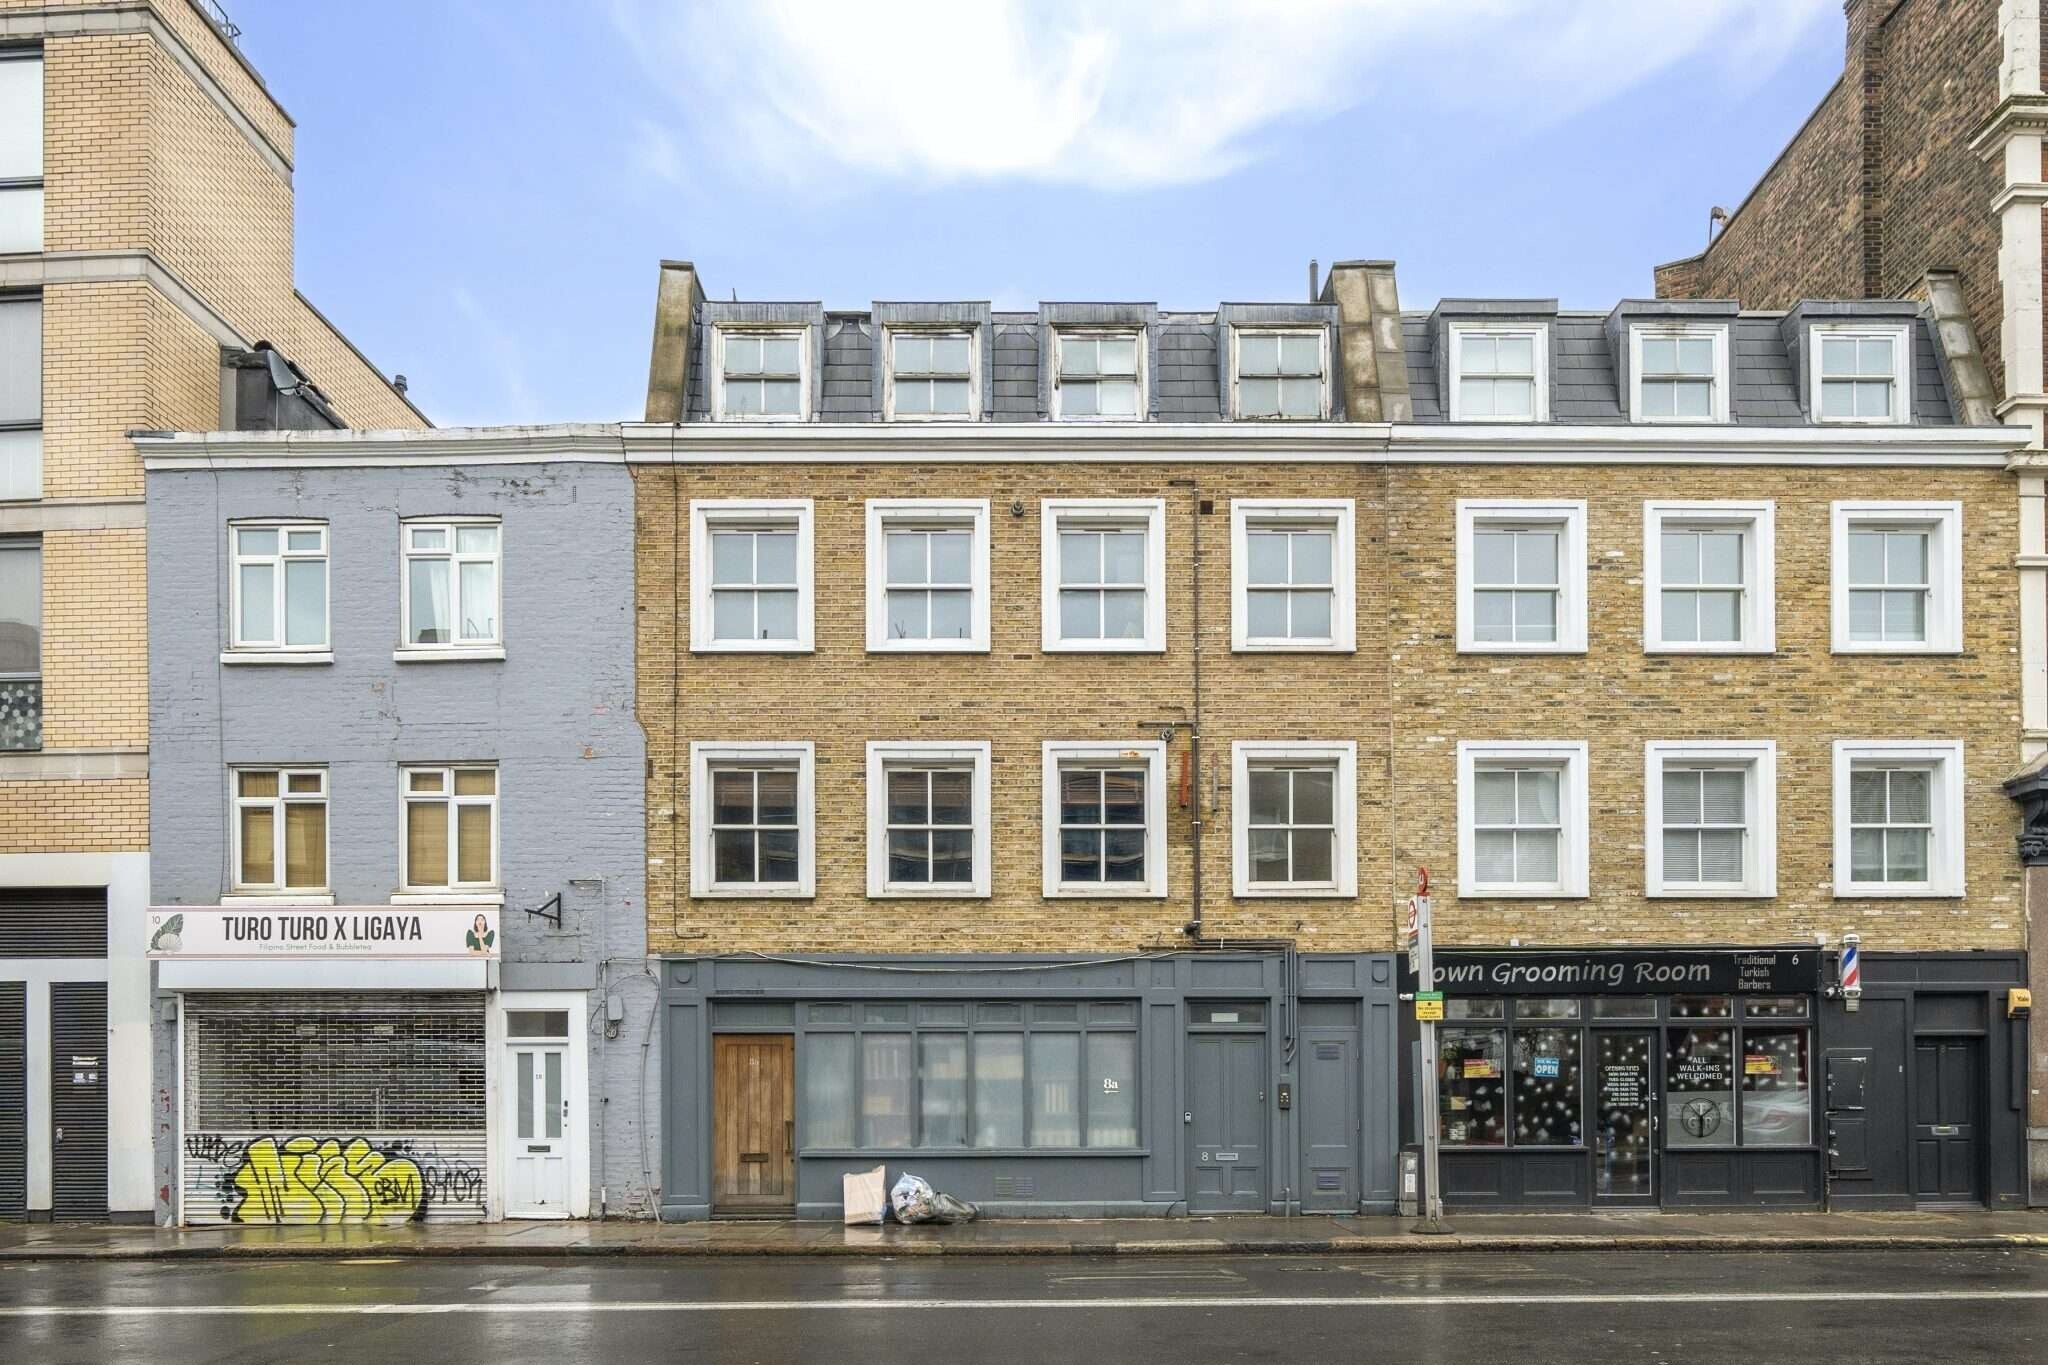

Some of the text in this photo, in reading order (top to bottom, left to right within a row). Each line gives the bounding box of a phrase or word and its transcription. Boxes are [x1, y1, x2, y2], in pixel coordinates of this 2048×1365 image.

[152, 916, 161, 925] 10
[222, 916, 422, 941] TURO TURO X LIGAYA
[286, 943, 307, 951] Street
[309, 943, 326, 951] Food
[1733, 954, 1776, 965] Traditional
[1792, 955, 1799, 965] 6
[1433, 959, 1710, 986] own Grooming Room
[1740, 967, 1769, 977] Turkish
[1738, 979, 1771, 990] Barbers
[1692, 1056, 1707, 1064] ALL
[1536, 1064, 1558, 1075] OPEN
[1679, 1064, 1720, 1072] WALK-INS
[1103, 1078, 1118, 1089] 8a
[1201, 1151, 1209, 1162] 8
